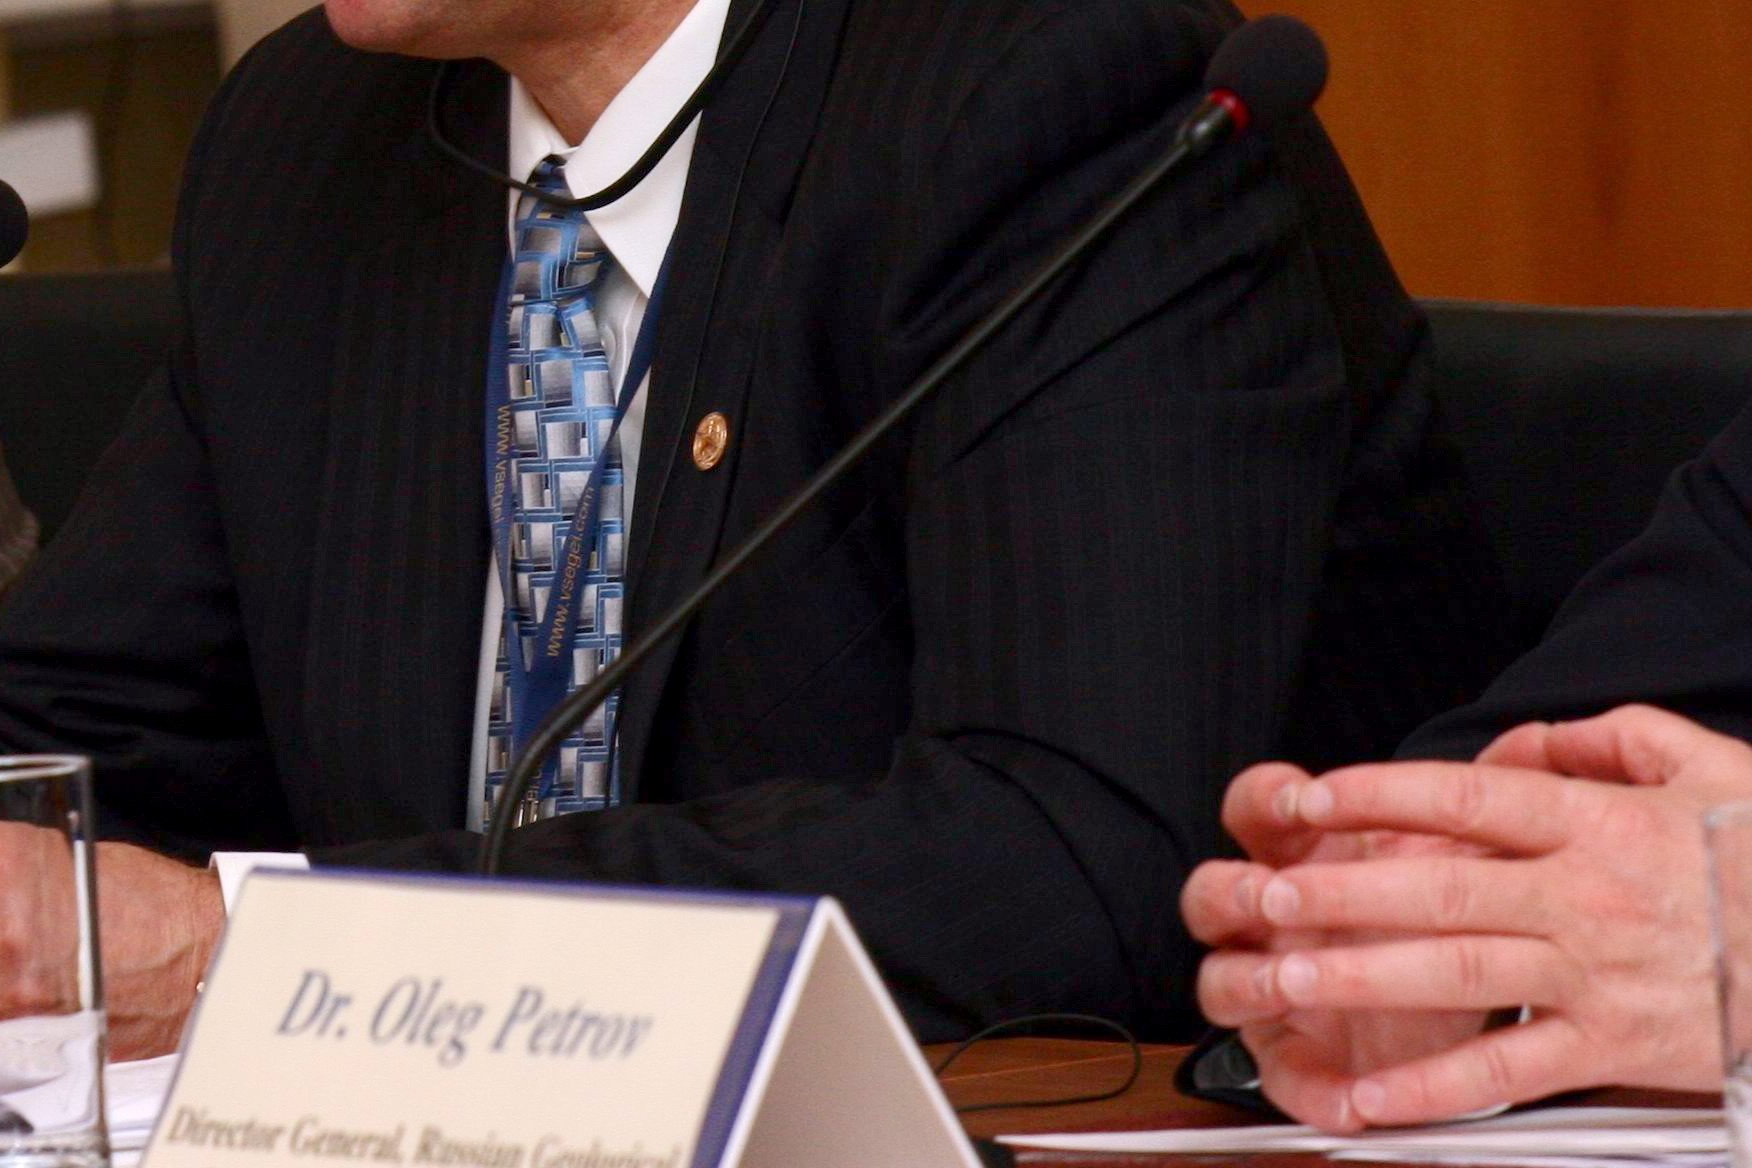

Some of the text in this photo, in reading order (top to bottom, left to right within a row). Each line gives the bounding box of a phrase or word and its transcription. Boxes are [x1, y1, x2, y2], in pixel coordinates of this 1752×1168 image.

[276, 968, 655, 1070] Dr. Oleg Petrov
[167, 1104, 286, 1154] Director
